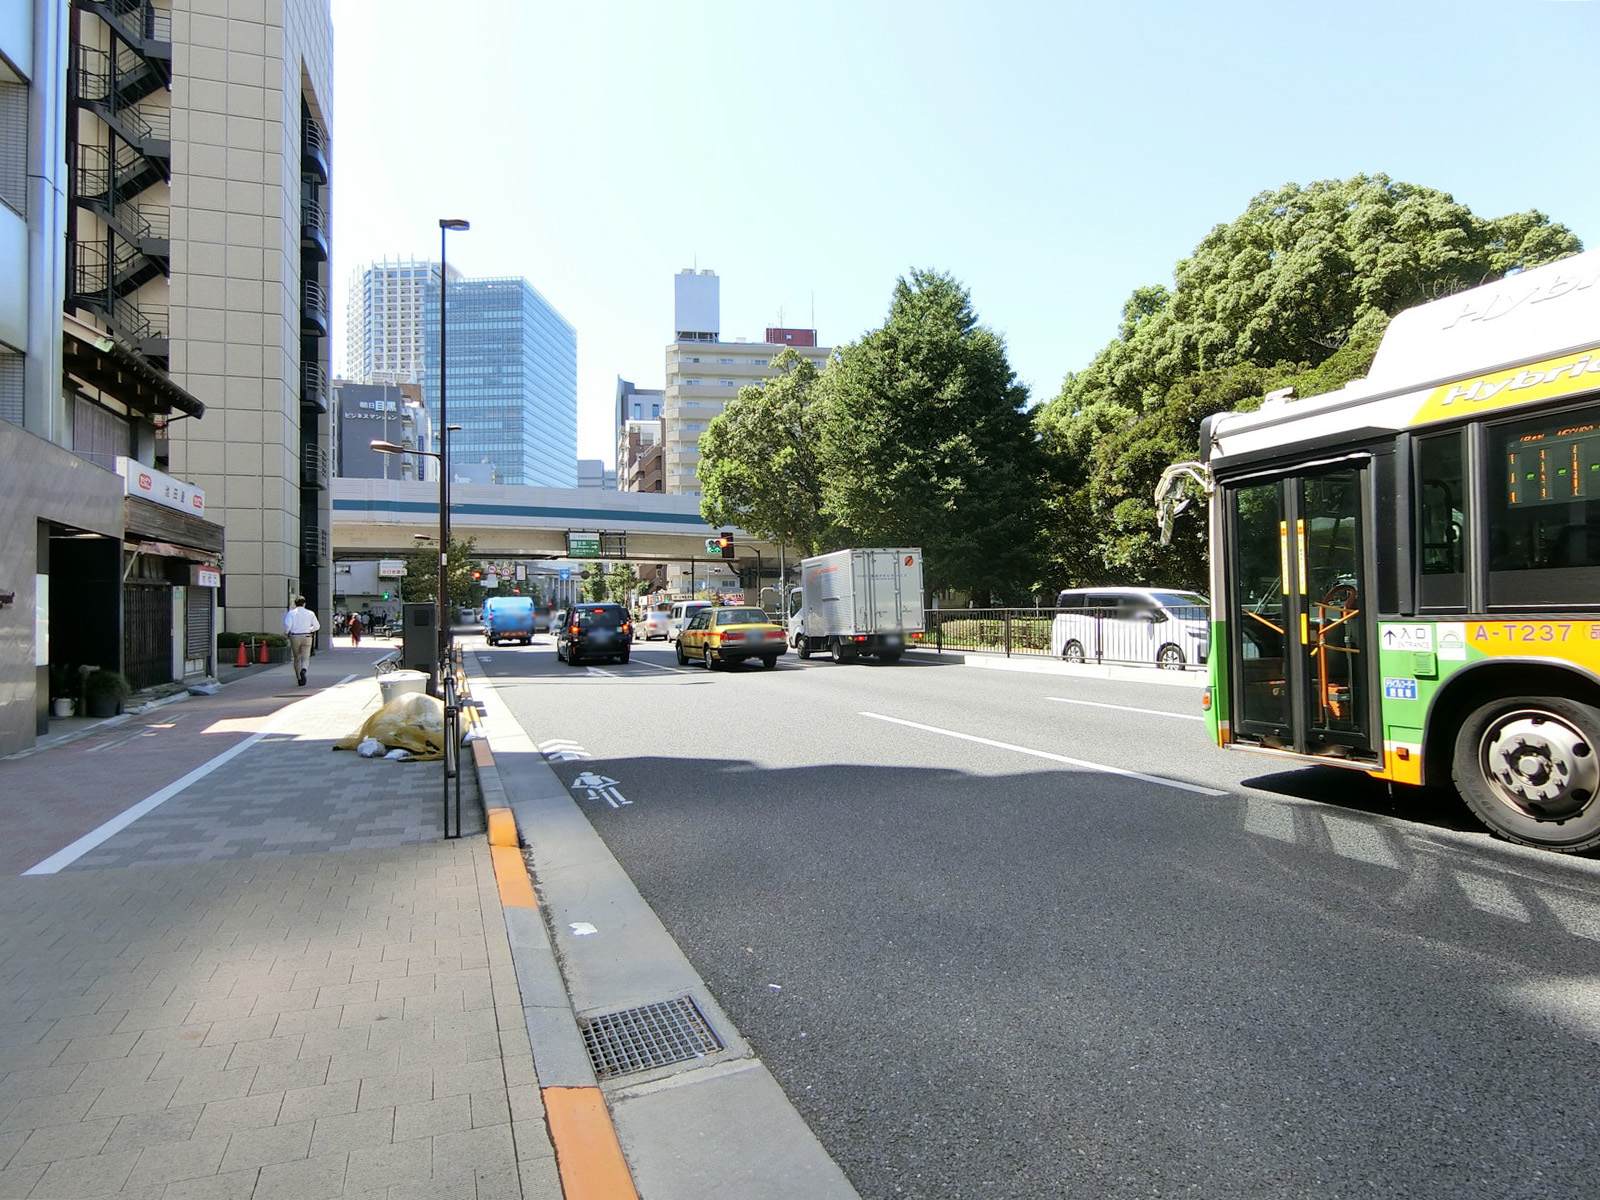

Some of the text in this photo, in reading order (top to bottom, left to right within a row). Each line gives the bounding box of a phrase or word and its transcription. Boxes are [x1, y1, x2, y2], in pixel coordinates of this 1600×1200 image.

[1401, 627, 1425, 639] 入口
[1475, 625, 1572, 641] A-T237
[1397, 641, 1430, 649] ENTRANCE
